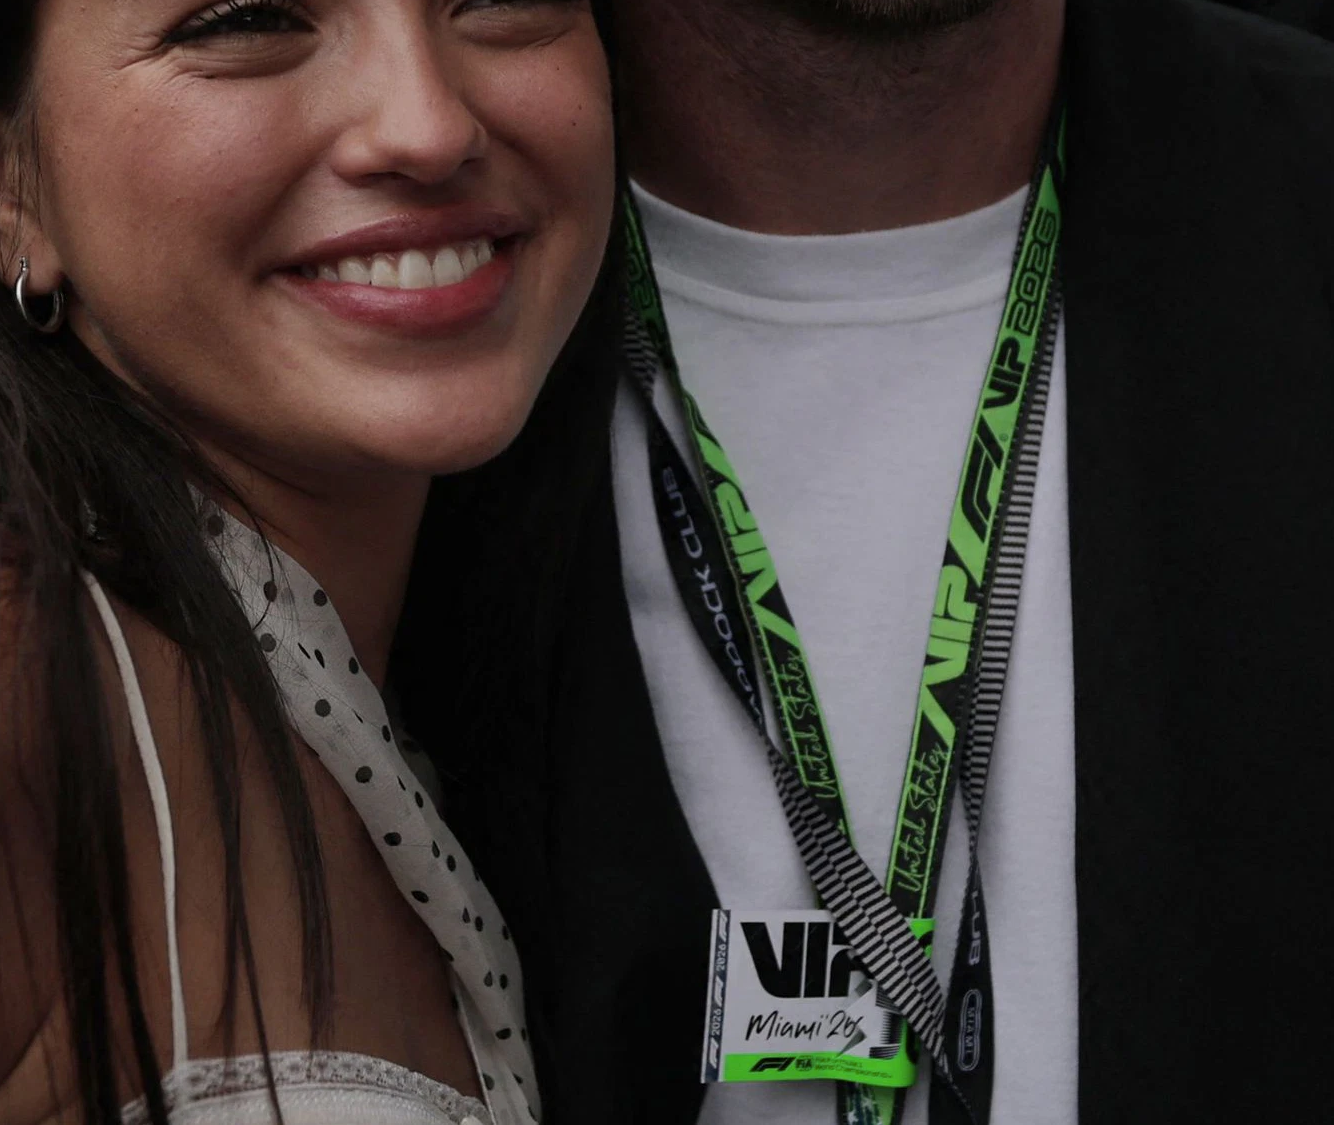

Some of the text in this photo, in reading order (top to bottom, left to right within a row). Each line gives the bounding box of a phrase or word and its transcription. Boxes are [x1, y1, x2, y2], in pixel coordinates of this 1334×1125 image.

[983, 336, 1024, 409] VIP
[1006, 209, 1057, 335] 2026
[714, 481, 778, 603] VIP
[662, 465, 764, 725] ADDOCK CLUB
[924, 565, 978, 687] VIP
[897, 742, 946, 893] United States
[717, 943, 728, 972] 2026
[968, 885, 982, 966] LUB
[712, 1008, 723, 1036] 2026
[745, 1010, 823, 1041] Miami
[965, 1006, 975, 1056] MIAMI
